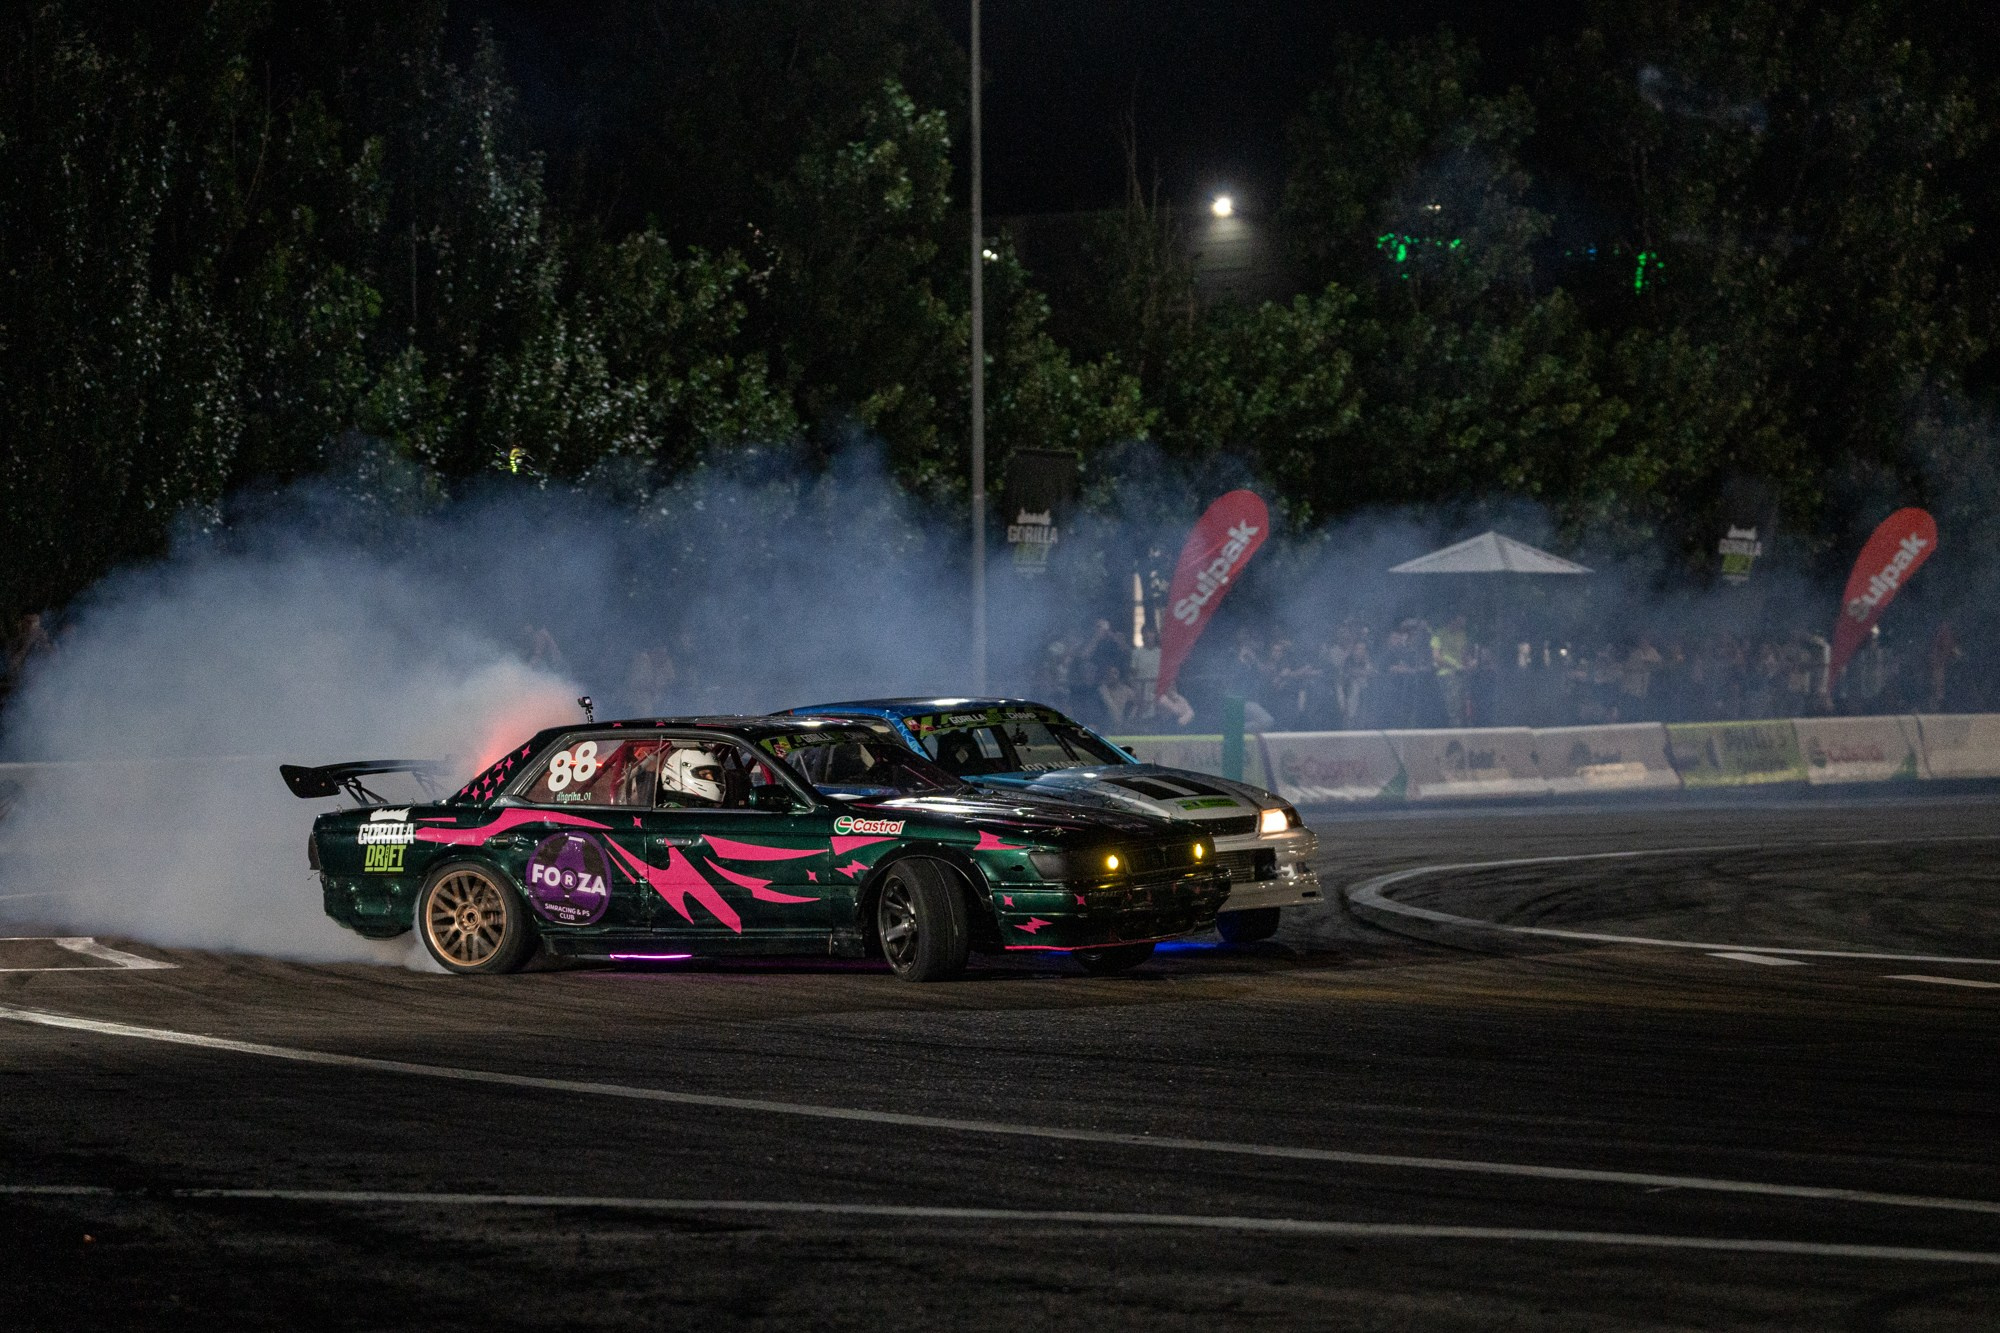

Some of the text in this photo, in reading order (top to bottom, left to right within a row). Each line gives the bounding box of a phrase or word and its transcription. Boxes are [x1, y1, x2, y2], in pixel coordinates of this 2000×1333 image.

[1174, 519, 1260, 626] Sulpak
[547, 740, 598, 792] 88
[852, 819, 904, 834] Castrol
[364, 844, 407, 872] DRIFT
[531, 863, 607, 896] FORZA
[544, 902, 577, 915] SIMRACING
[559, 912, 575, 921] CLUB
